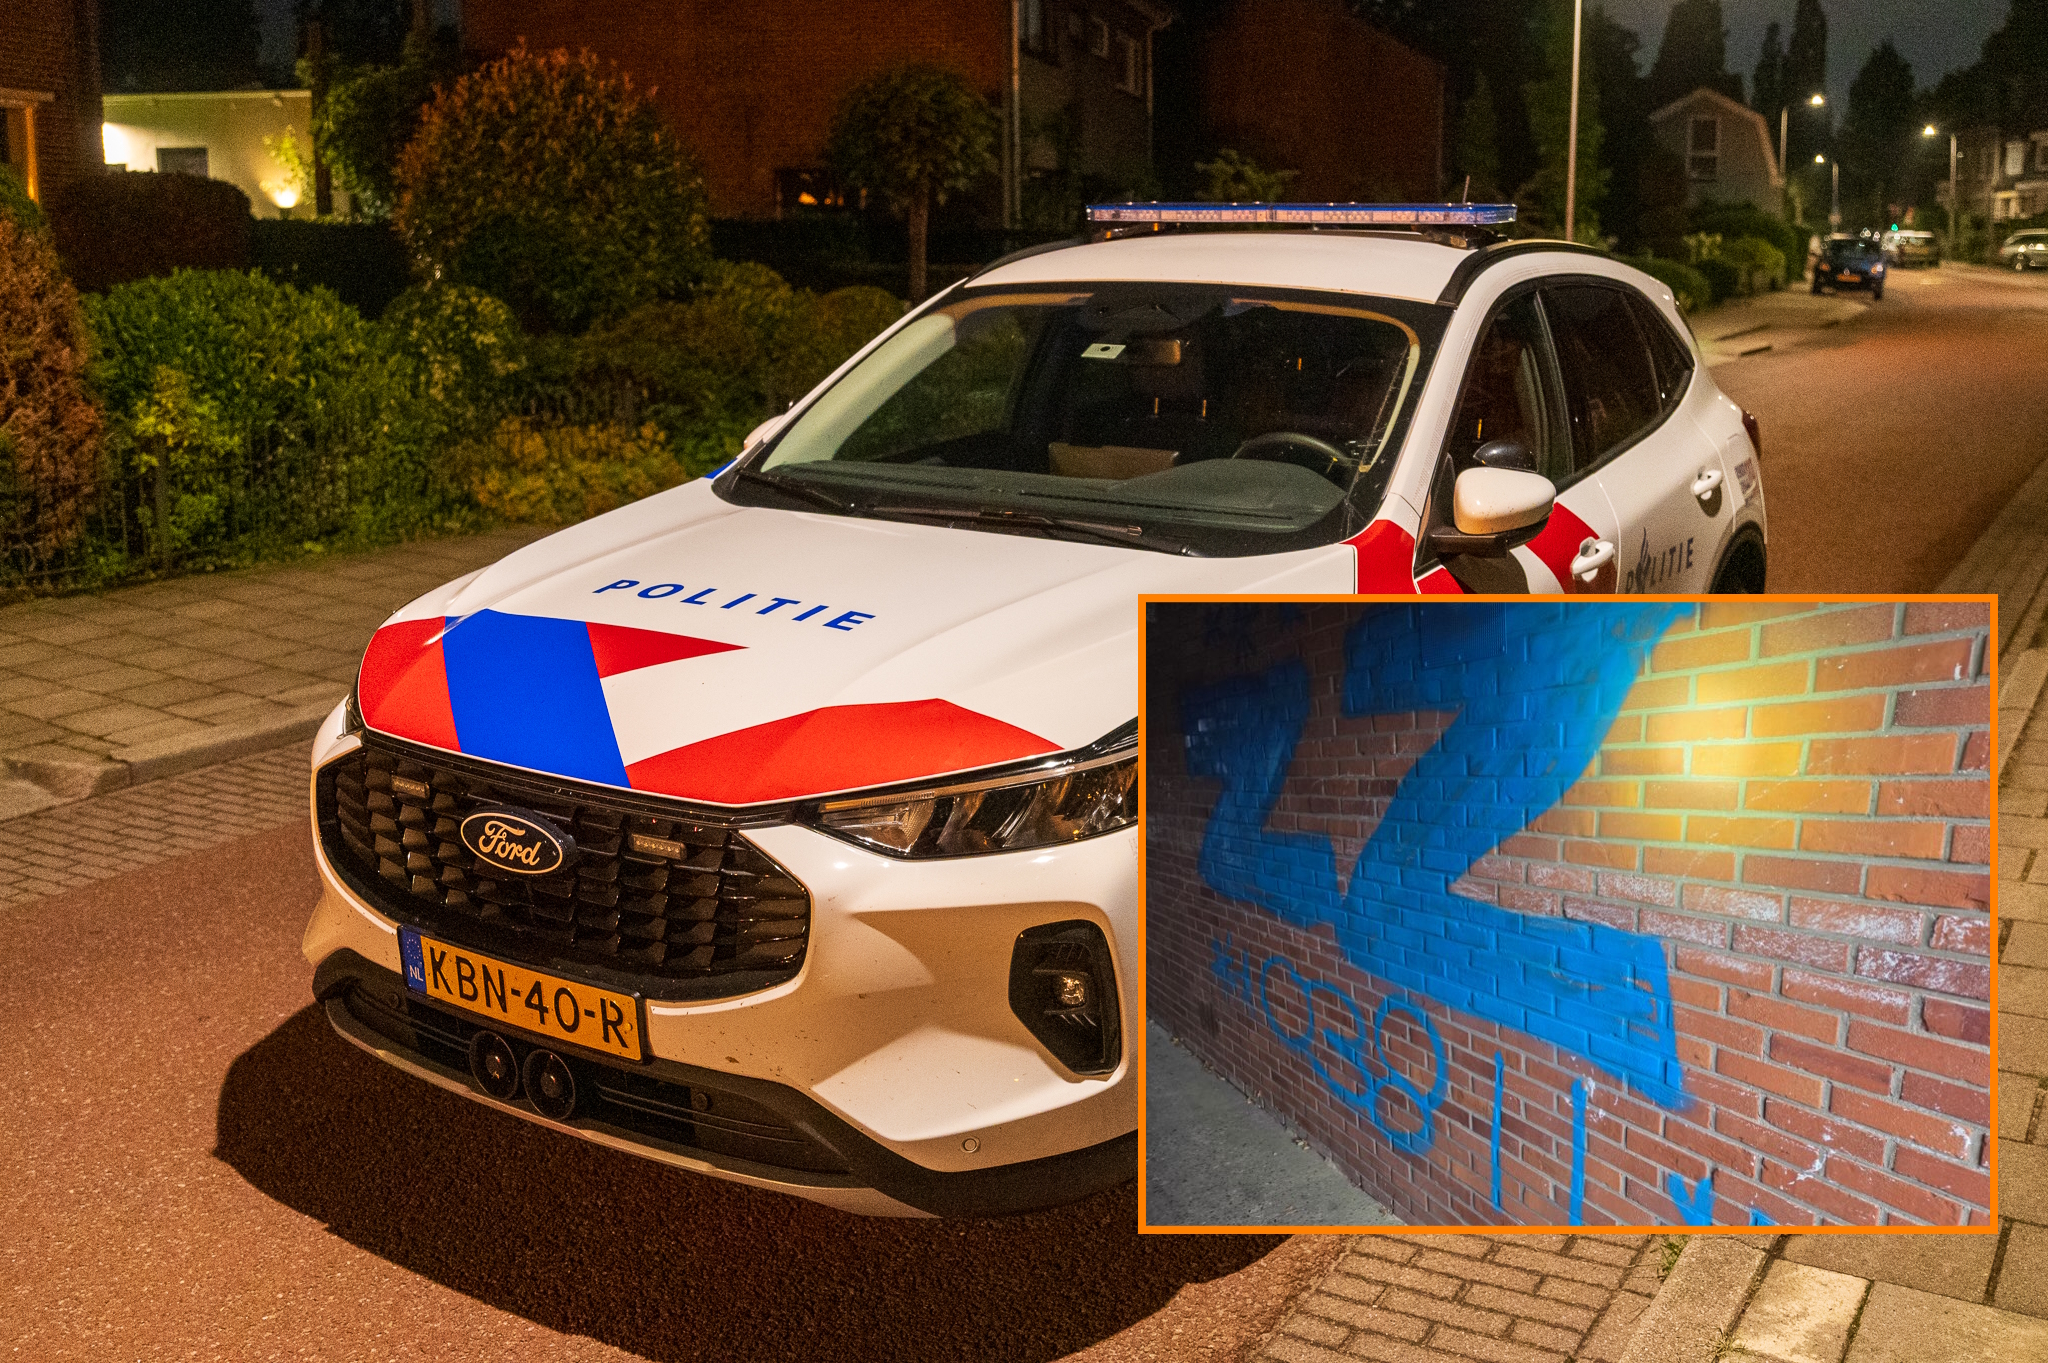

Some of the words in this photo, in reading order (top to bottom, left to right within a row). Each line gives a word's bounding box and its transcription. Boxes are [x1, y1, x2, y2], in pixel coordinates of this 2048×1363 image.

[592, 578, 877, 632] POLITIE
[478, 820, 542, 866] Ford
[409, 964, 424, 982] NL
[429, 946, 629, 1049] KBN-40-R
